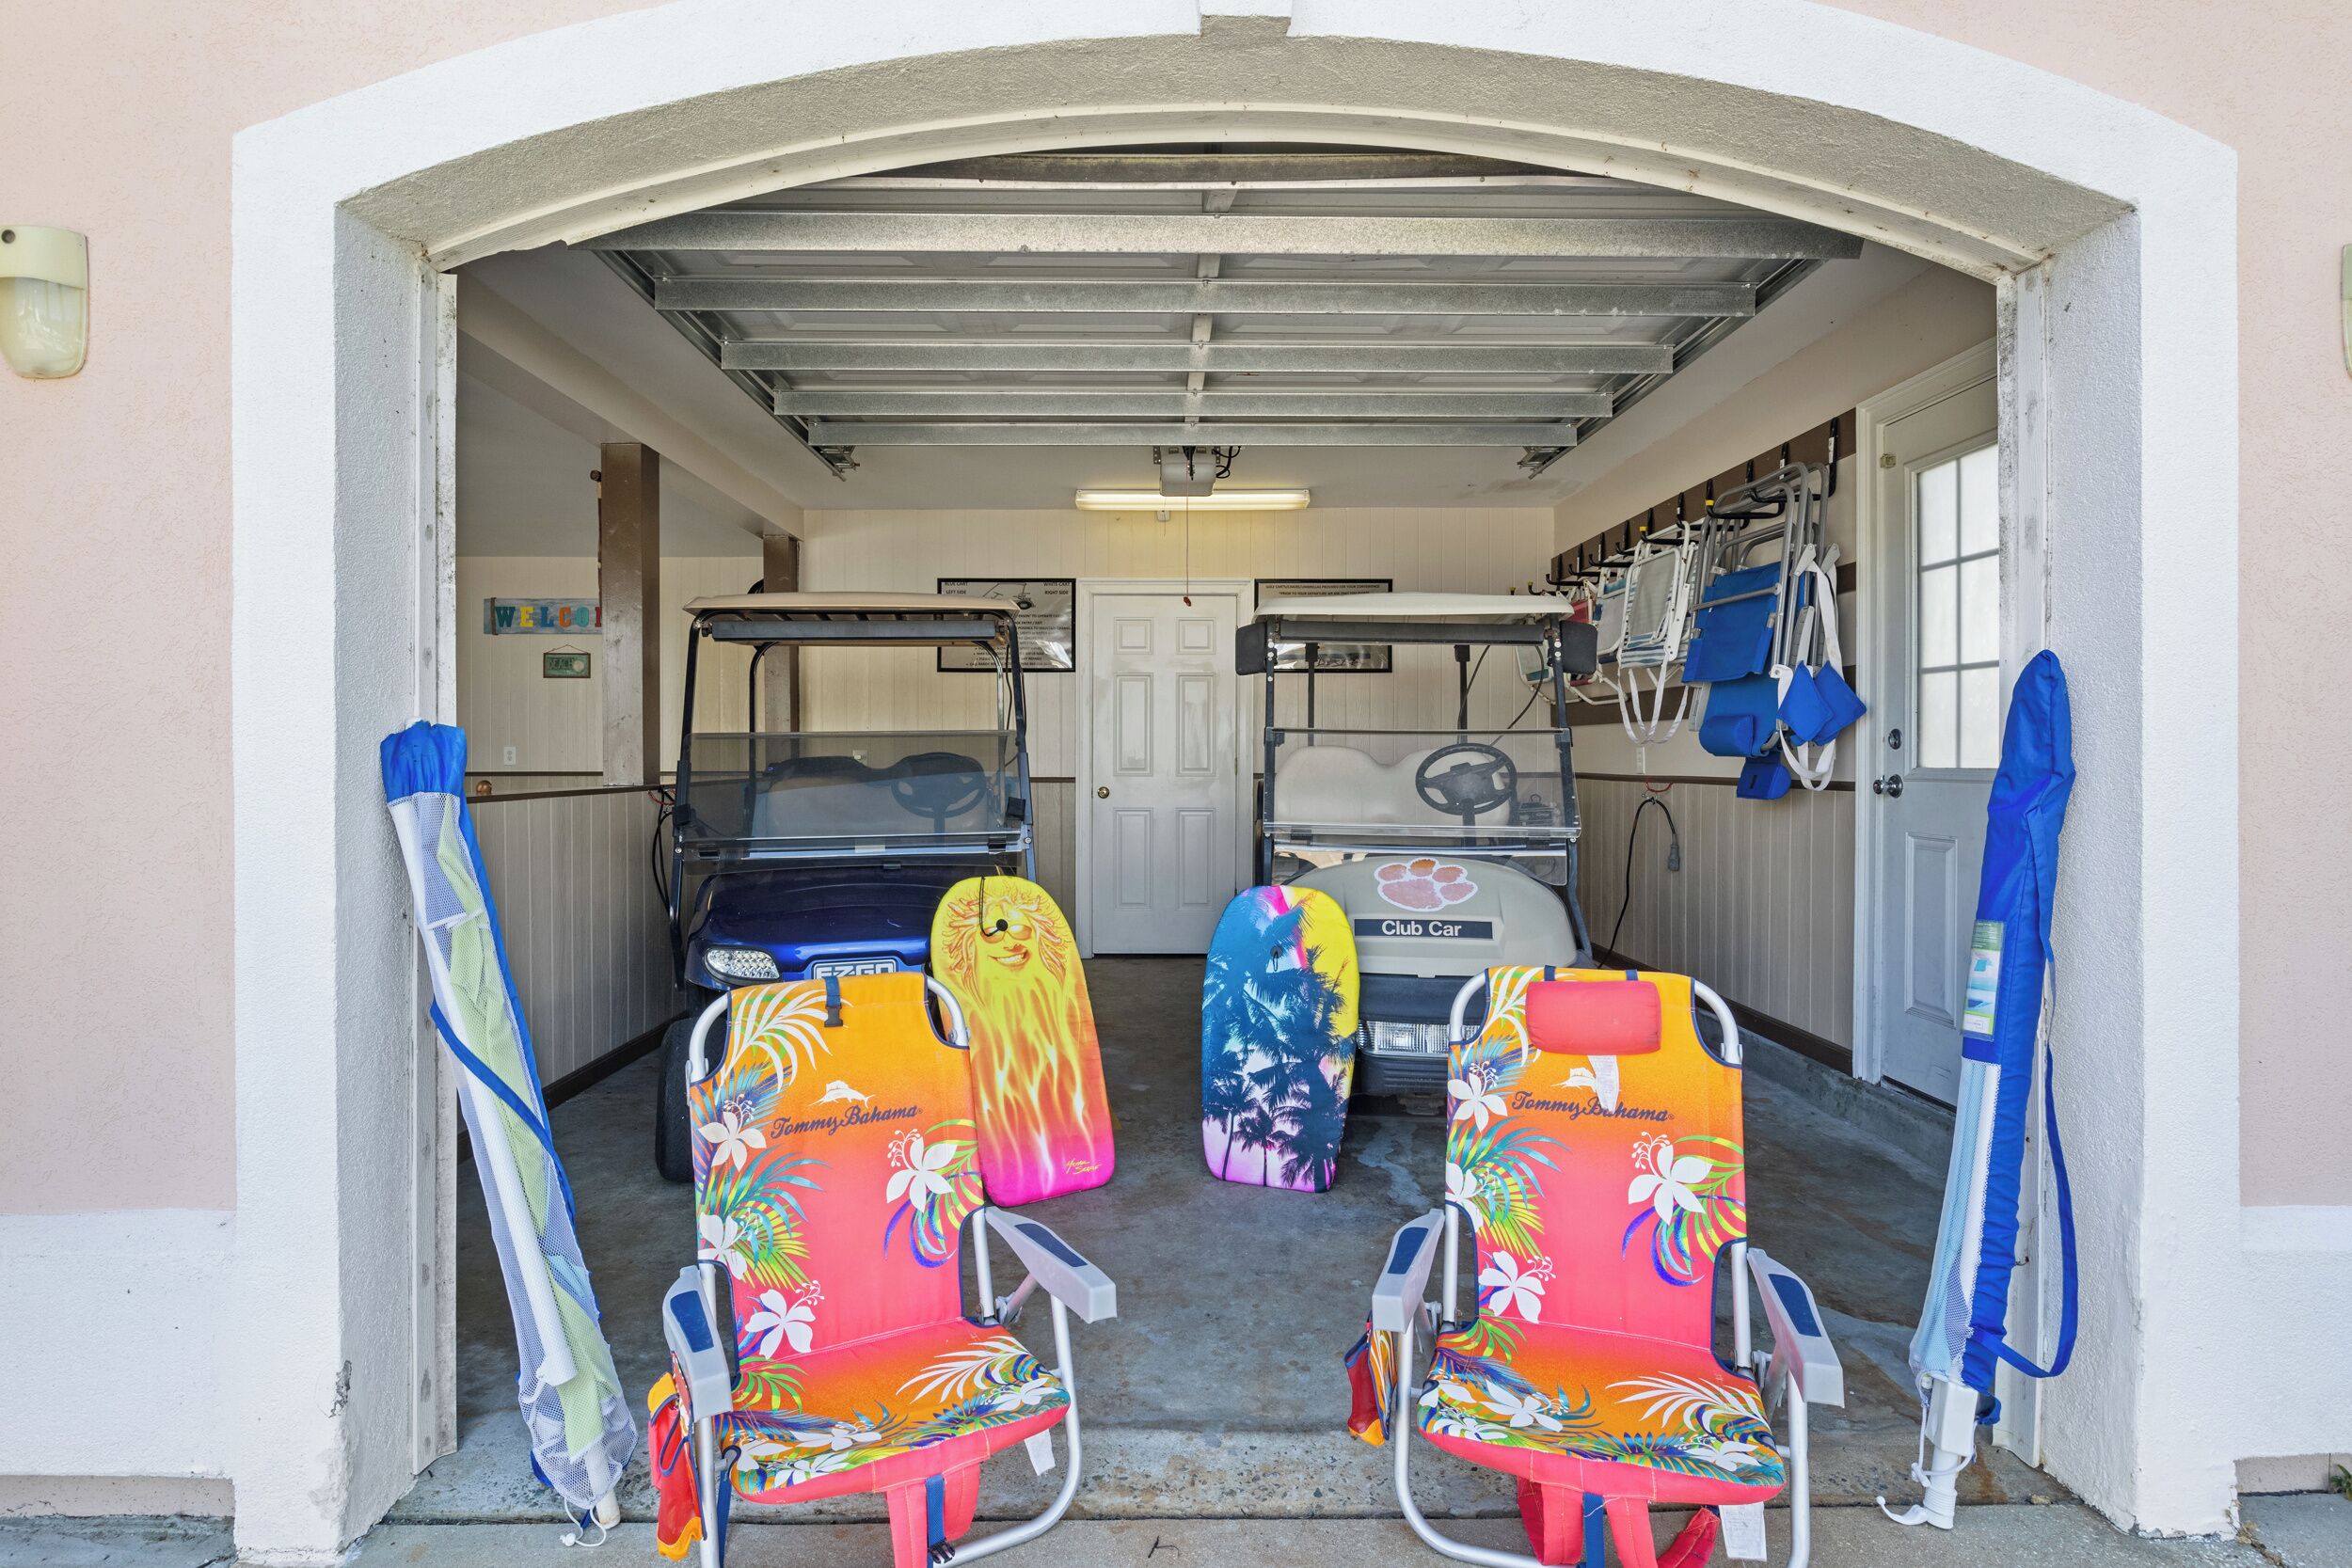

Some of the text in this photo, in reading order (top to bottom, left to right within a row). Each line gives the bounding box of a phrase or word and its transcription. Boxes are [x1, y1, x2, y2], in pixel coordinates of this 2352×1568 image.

[1381, 919, 1463, 937] Club Car
[770, 1103, 918, 1139] Tommy Bahama
[1511, 1090, 1585, 1121] Tommy
